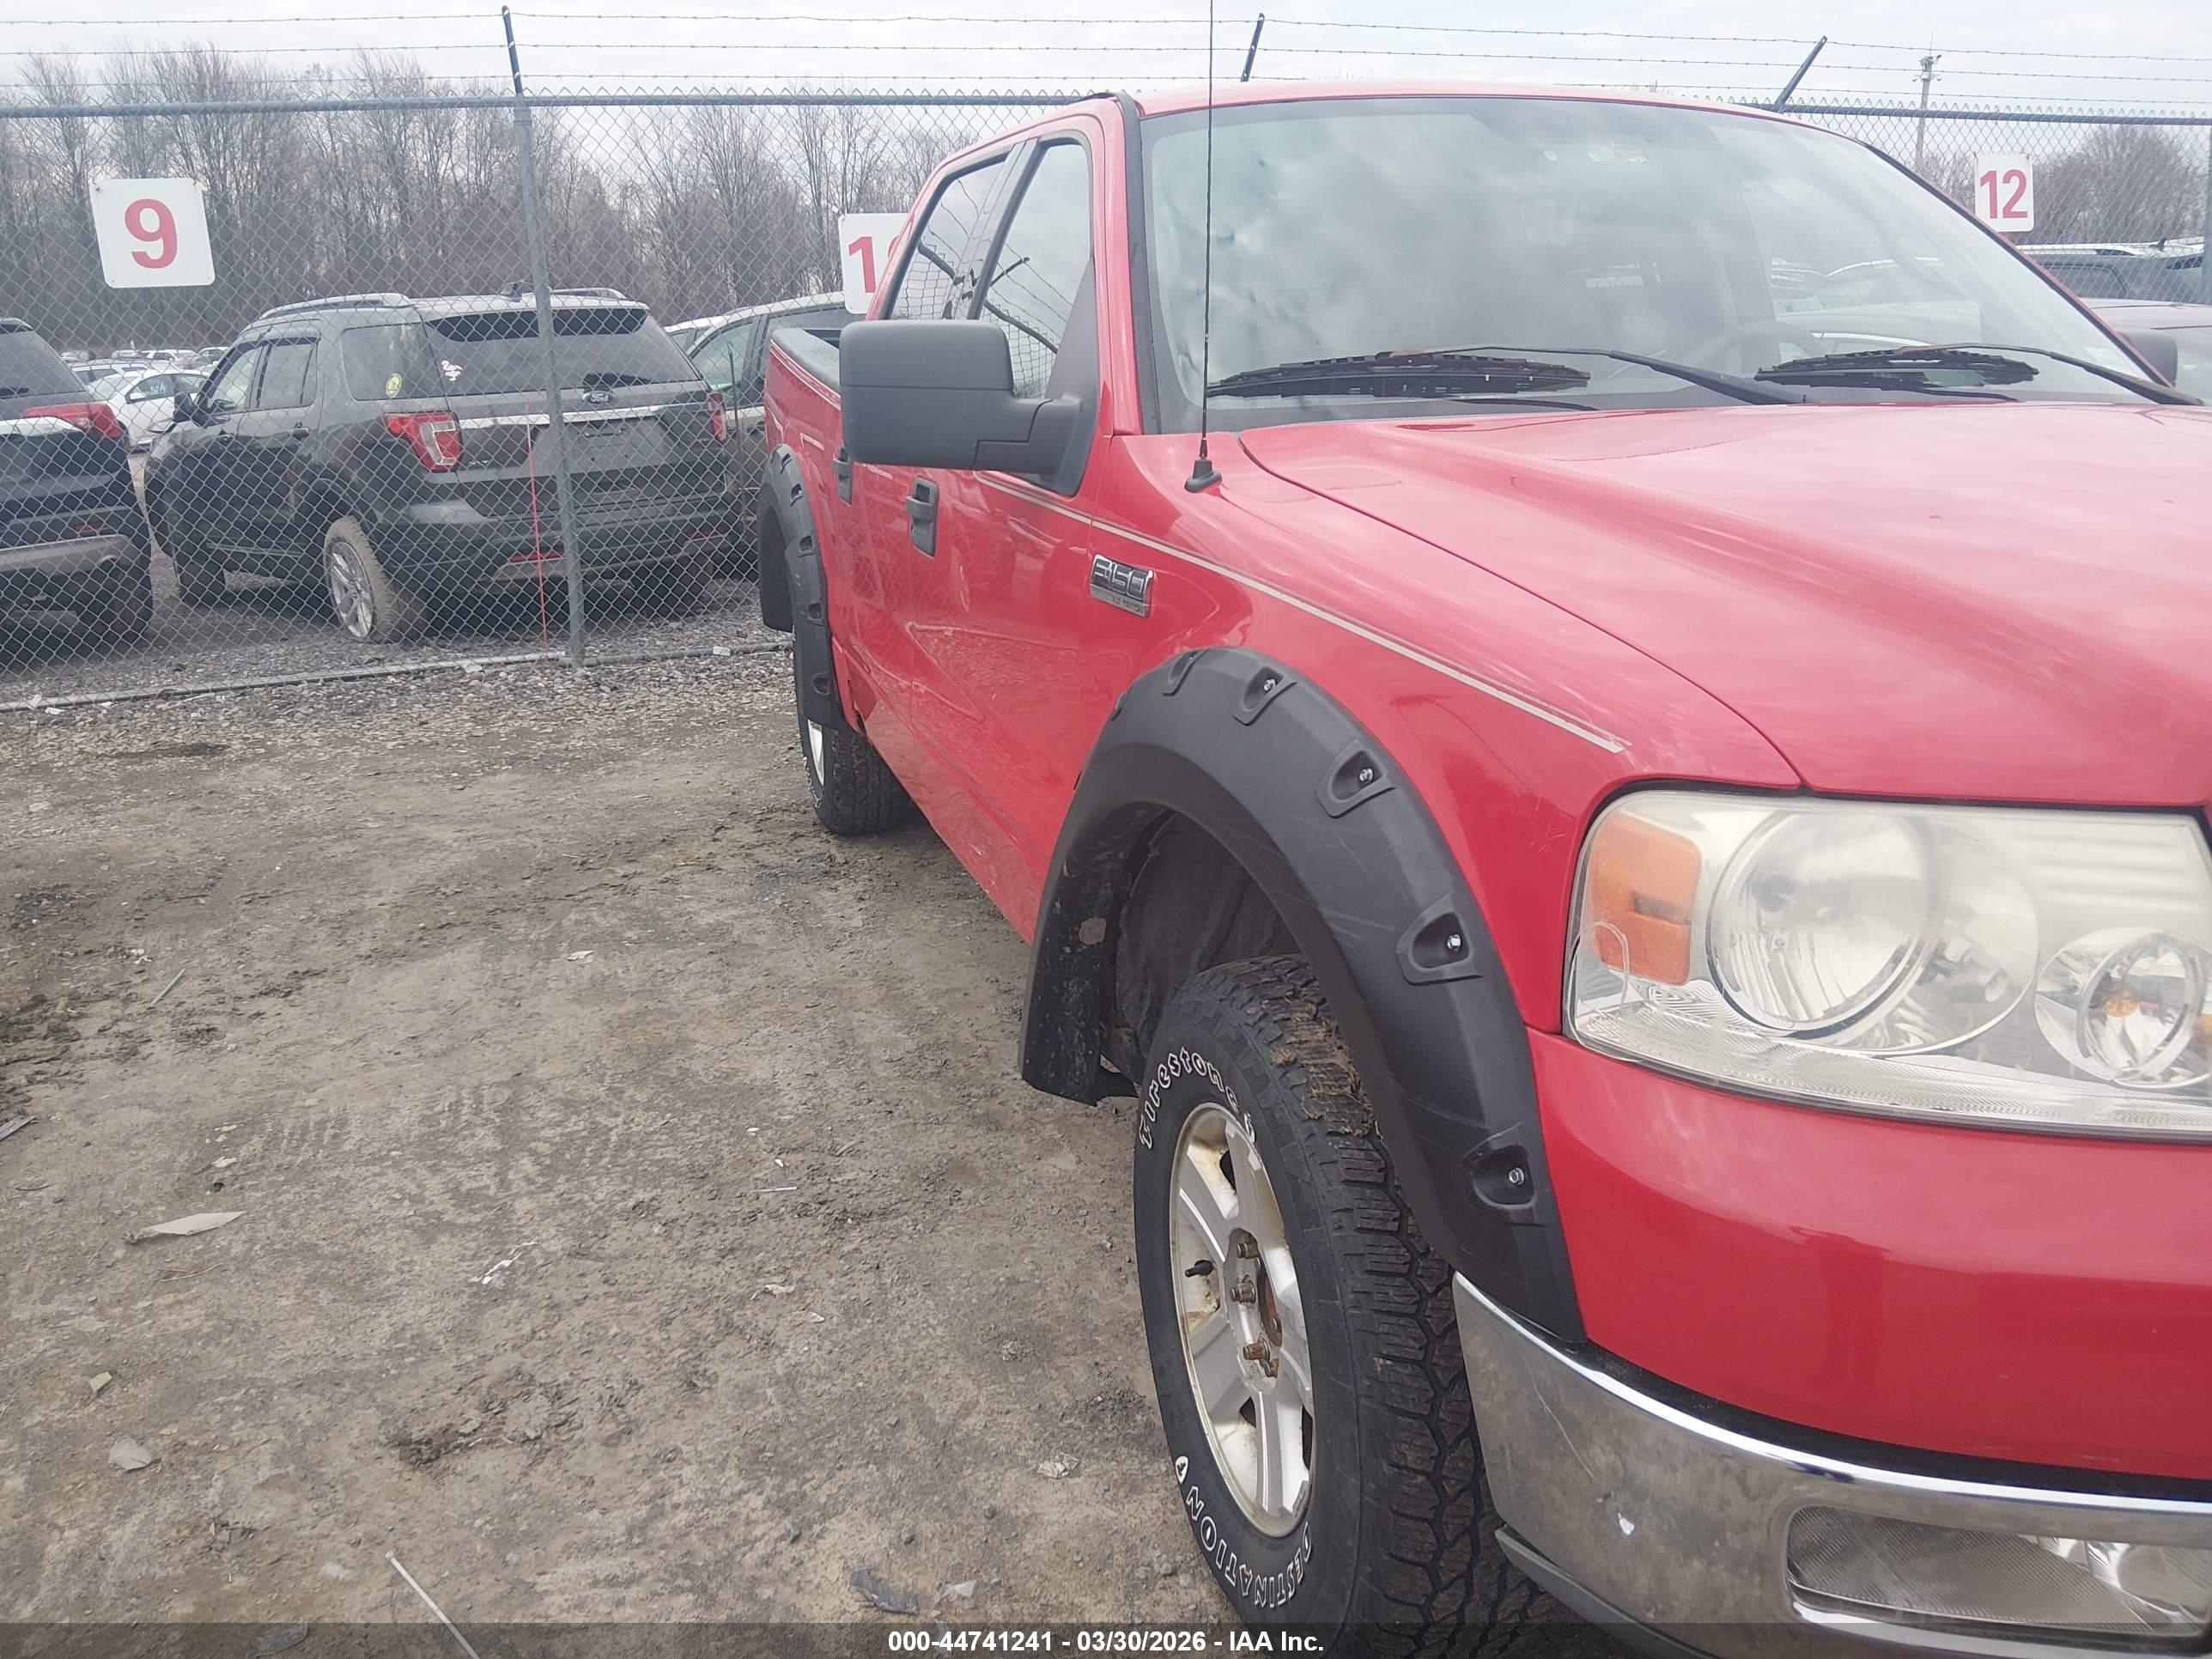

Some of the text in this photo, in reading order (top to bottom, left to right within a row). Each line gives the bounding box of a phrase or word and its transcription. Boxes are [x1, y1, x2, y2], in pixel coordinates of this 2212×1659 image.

[1979, 168, 2028, 219] 12
[124, 198, 178, 269] 9
[848, 235, 901, 294] 1
[1186, 1486, 1312, 1608] DESTINATION
